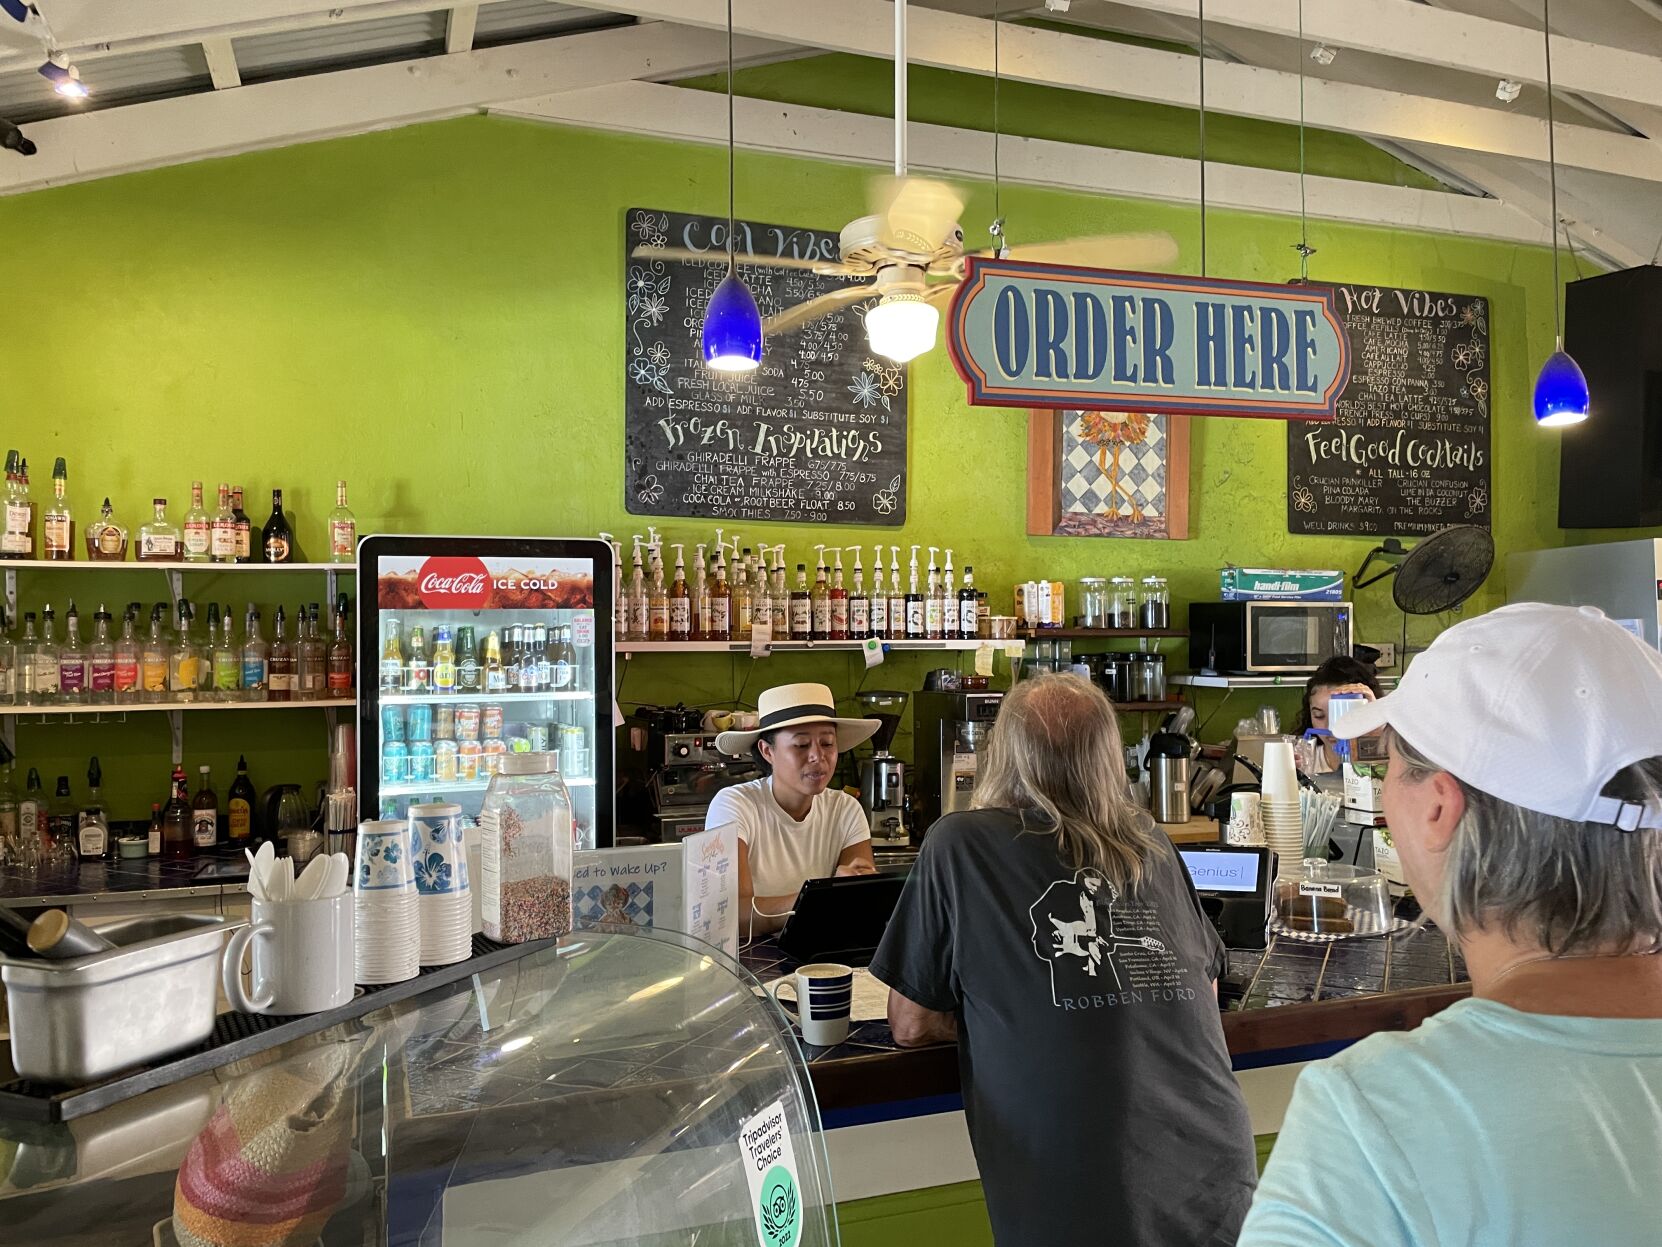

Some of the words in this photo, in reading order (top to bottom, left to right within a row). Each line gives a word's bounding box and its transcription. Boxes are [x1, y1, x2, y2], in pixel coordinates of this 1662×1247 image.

[683, 221, 754, 257] Cool
[768, 228, 842, 263] Vibe
[708, 260, 751, 274] COFEE
[743, 274, 772, 285] ATTE
[1339, 285, 1383, 314] Hot
[1392, 290, 1457, 317] Vibes
[1345, 321, 1367, 331] OFFEE
[1371, 325, 1399, 334] REFILLS
[1373, 316, 1402, 326] BREWED
[1404, 318, 1433, 329] COFFEE
[992, 285, 1175, 388] ORDER
[1193, 301, 1317, 396] HERE
[1384, 333, 1408, 341] LATTE
[1365, 345, 1408, 355] AMERICANO
[1385, 340, 1408, 350] MOCHA
[1364, 360, 1408, 370] CAPPUCCINO
[728, 373, 758, 385] JUICE
[762, 367, 784, 378] SODA
[1368, 368, 1406, 378] ESPRESSO
[678, 377, 709, 390] FRESH
[713, 381, 743, 394] LOCAL
[1353, 375, 1390, 385] ESPRESSO
[1392, 377, 1406, 386] CON
[1407, 378, 1428, 388] PANNA
[1369, 383, 1388, 393] TAZO
[1391, 385, 1406, 394] TEA
[692, 390, 722, 402] GLASS
[725, 393, 736, 403] OF
[1359, 392, 1376, 400] CHAI
[1380, 392, 1394, 402] TEA
[1398, 395, 1423, 405] LATTE
[646, 397, 664, 408] ADD
[669, 398, 720, 413] ESPRESSO
[737, 405, 752, 415] ADD
[757, 407, 788, 418] FLAVOR
[802, 410, 856, 424] SUBSTITUTE
[860, 413, 877, 424] SOY
[1339, 408, 1368, 418] FRENCH
[1371, 410, 1394, 420] PRESS
[1410, 411, 1430, 421] CUPS)
[1367, 402, 1386, 411] BEST
[1390, 402, 1404, 411] HOT
[1407, 403, 1446, 414] CHOCOLATE
[1366, 418, 1380, 427] ADD
[1382, 418, 1406, 429] FLAVOR
[1418, 421, 1462, 433] SUBSTITUTE
[1464, 424, 1477, 434] SOY
[658, 413, 744, 450] Frozen
[748, 421, 882, 462] Inspirations
[1304, 427, 1347, 464] Feel
[1349, 429, 1406, 467] Good
[1406, 437, 1484, 471] Cocktails
[687, 451, 748, 466] GHIRADELLI
[755, 455, 797, 469] FRAPPE
[656, 460, 713, 474] GHIRADELLI
[720, 464, 757, 477] FRAPPE
[762, 468, 777, 478] with
[780, 468, 830, 481] ESPRESSO
[1369, 468, 1383, 479] ALL
[694, 473, 718, 484] CHAI
[722, 475, 745, 487] TEA
[752, 477, 794, 489] FRAPPE
[1308, 474, 1340, 486] CRUCIAN
[1341, 477, 1382, 488] PAINKILLER
[1397, 479, 1428, 488] CRUCIAN
[1430, 479, 1469, 489] CONFUSION
[692, 483, 708, 494] ICE
[711, 485, 745, 496] CREAM
[749, 487, 805, 500] MILKSHAKE
[1342, 486, 1369, 496] COLADA
[1436, 489, 1468, 499] COCONUT
[682, 493, 706, 504] COCA
[708, 494, 731, 505] COLA
[743, 496, 768, 507] ROOT
[770, 498, 794, 509] BEER
[800, 499, 829, 511] FLOAT
[1324, 494, 1355, 505] BLOODY
[1357, 496, 1379, 506] MARY
[1406, 497, 1422, 507] THE
[1424, 498, 1457, 507] BUZZER
[1400, 506, 1414, 515] THE
[1418, 506, 1443, 516] ROCKS
[1303, 520, 1325, 531] WELL
[1327, 521, 1355, 531] DRINKS
[421, 572, 488, 594] Coca-Cola
[493, 580, 516, 589] ICE
[520, 580, 557, 590] COLD
[1254, 580, 1300, 591] handi-film
[594, 866, 606, 877] to
[610, 864, 641, 877] Wake
[644, 861, 667, 876] Up?
[1061, 990, 1143, 1011] ROBBEN
[1151, 987, 1196, 1001] FORD
[743, 1113, 782, 1147] Tripadvisor
[749, 1126, 782, 1160] Travelers'
[756, 1146, 782, 1172] Choice
